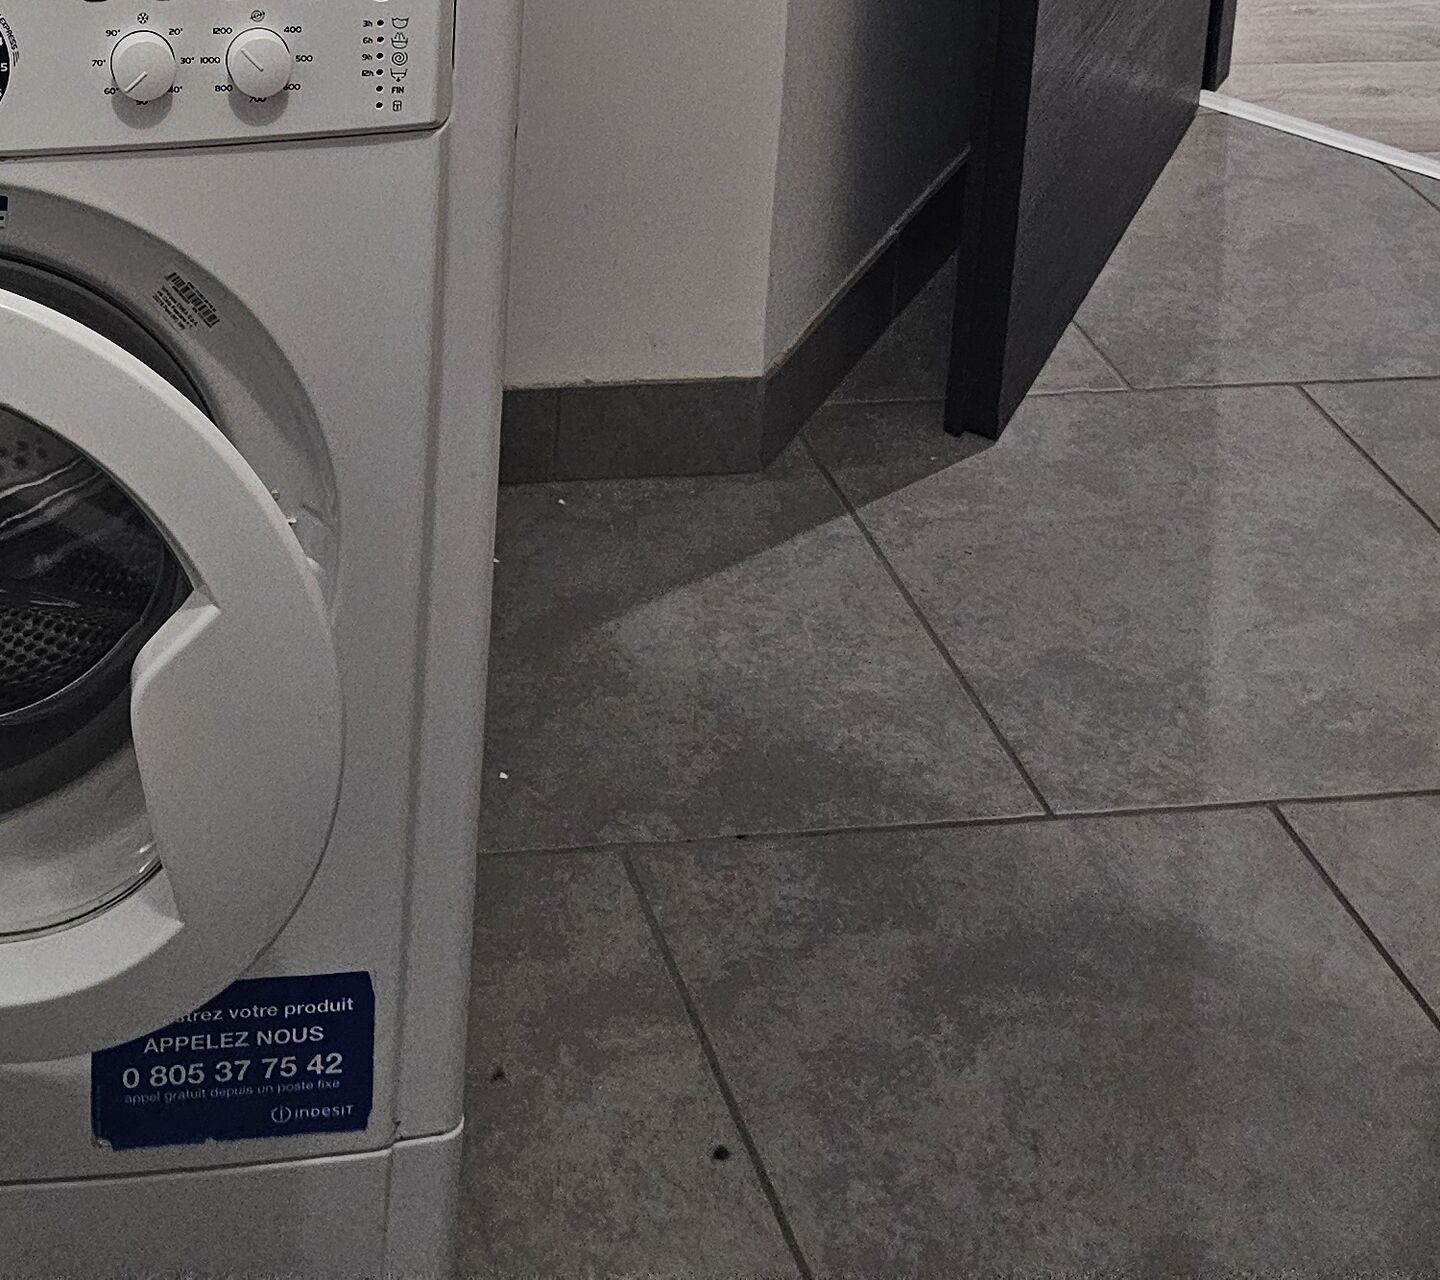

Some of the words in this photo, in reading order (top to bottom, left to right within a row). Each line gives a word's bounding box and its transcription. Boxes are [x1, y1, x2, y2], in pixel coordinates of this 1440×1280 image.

[295, 54, 313, 62] 500
[0, 63, 7, 71] 5
[214, 84, 233, 92] 800
[283, 83, 301, 91] 600
[392, 86, 404, 94] FIN
[229, 1005, 277, 1020] votre
[285, 997, 354, 1019] produit
[144, 1031, 250, 1053] APPELEZ
[257, 1026, 324, 1046] NOUS
[123, 1068, 140, 1088] 0
[149, 1062, 205, 1087] 805
[215, 1059, 250, 1082] 37
[262, 1056, 297, 1079] 75
[307, 1052, 343, 1075] 42
[124, 1091, 160, 1104] appel
[164, 1087, 206, 1102] gratuit
[210, 1085, 253, 1099] depuis
[278, 1081, 313, 1094] poste
[318, 1080, 340, 1089] fixe
